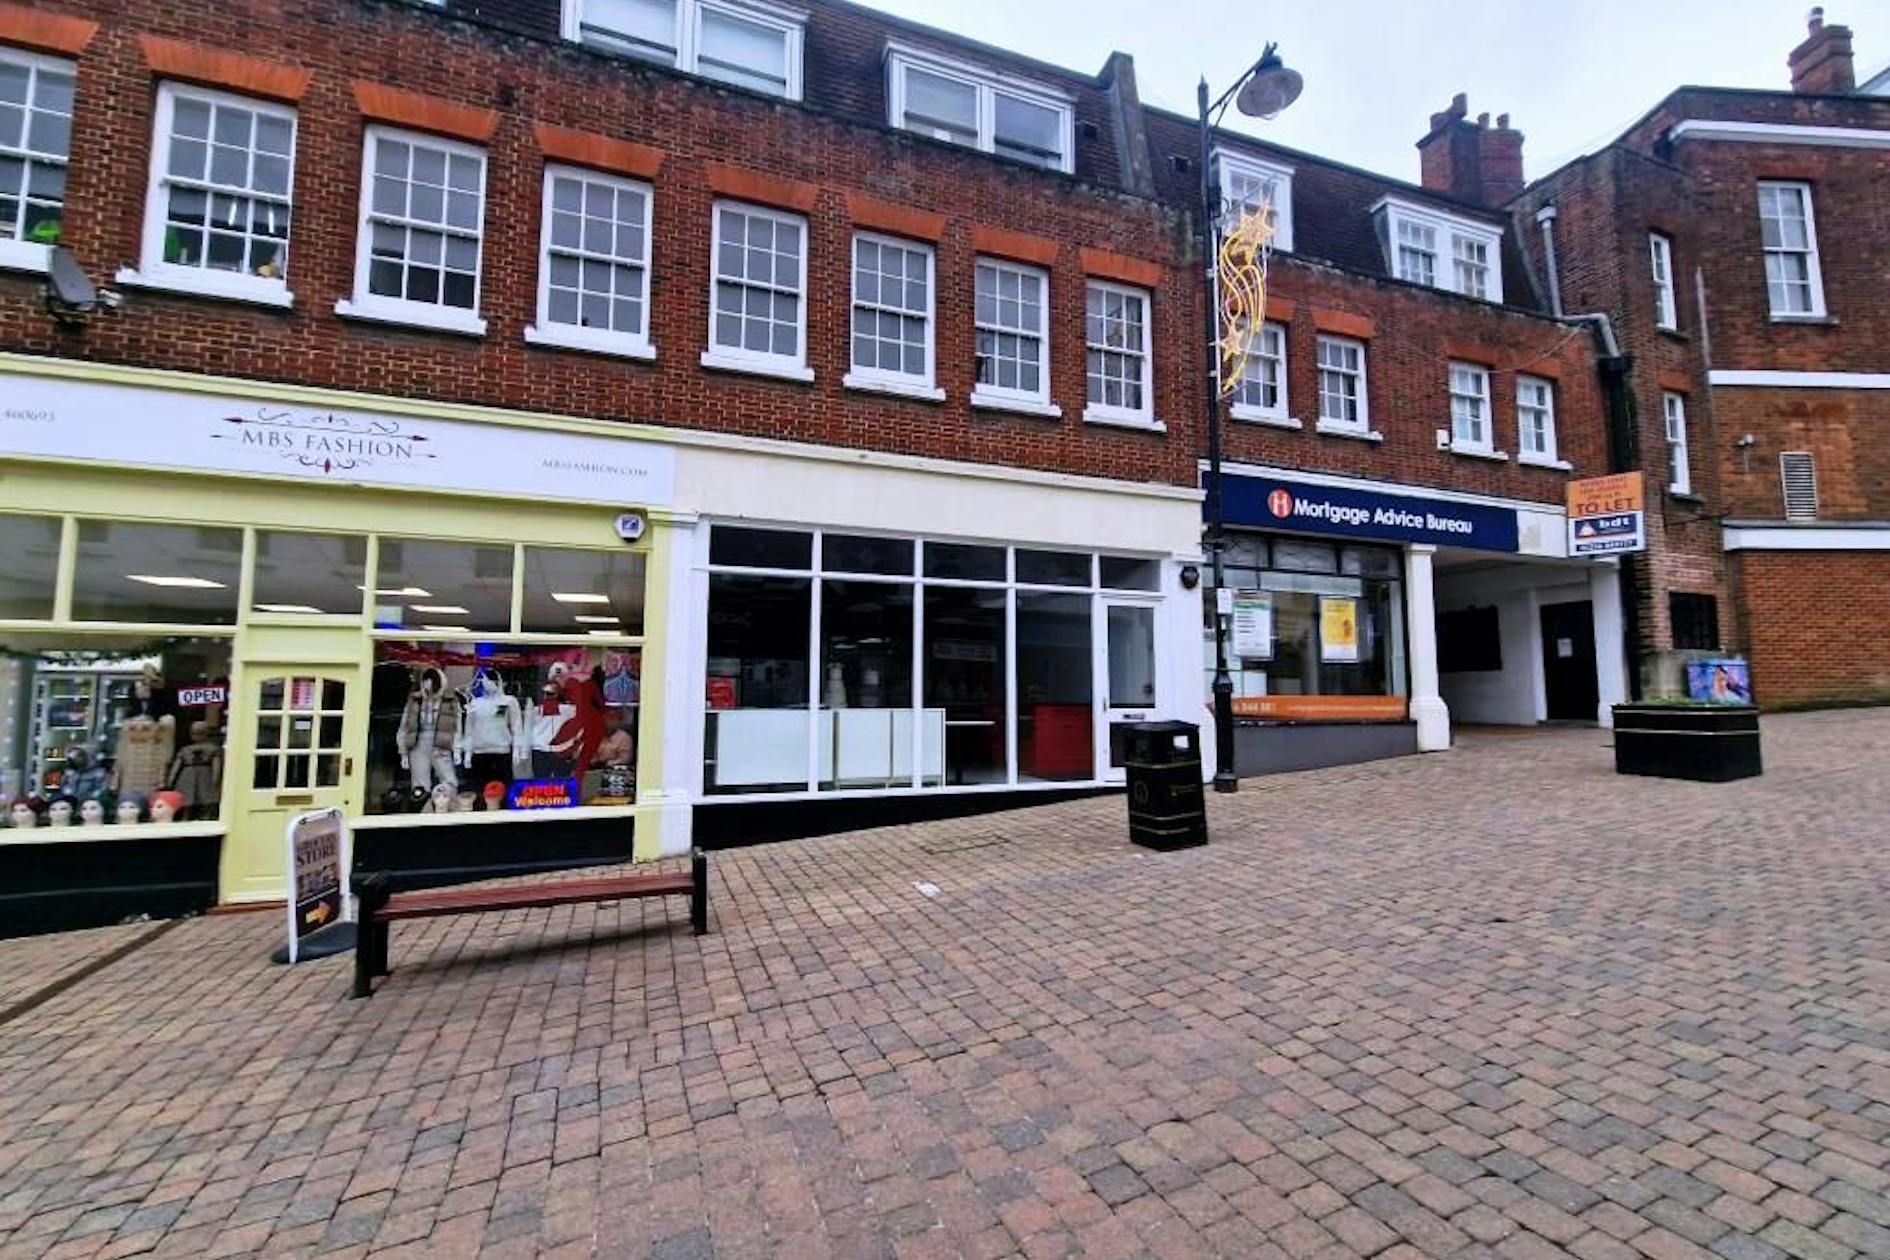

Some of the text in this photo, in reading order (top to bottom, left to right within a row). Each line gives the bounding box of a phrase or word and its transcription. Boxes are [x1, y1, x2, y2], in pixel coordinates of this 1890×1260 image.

[242, 429, 412, 458] MBS FASHION
[1294, 498, 1473, 534] Mortgage Advice Bureau
[1576, 498, 1633, 514] TO LET
[183, 690, 220, 703] OPEN
[514, 796, 571, 808] Welcome
[297, 843, 336, 867] STORE
